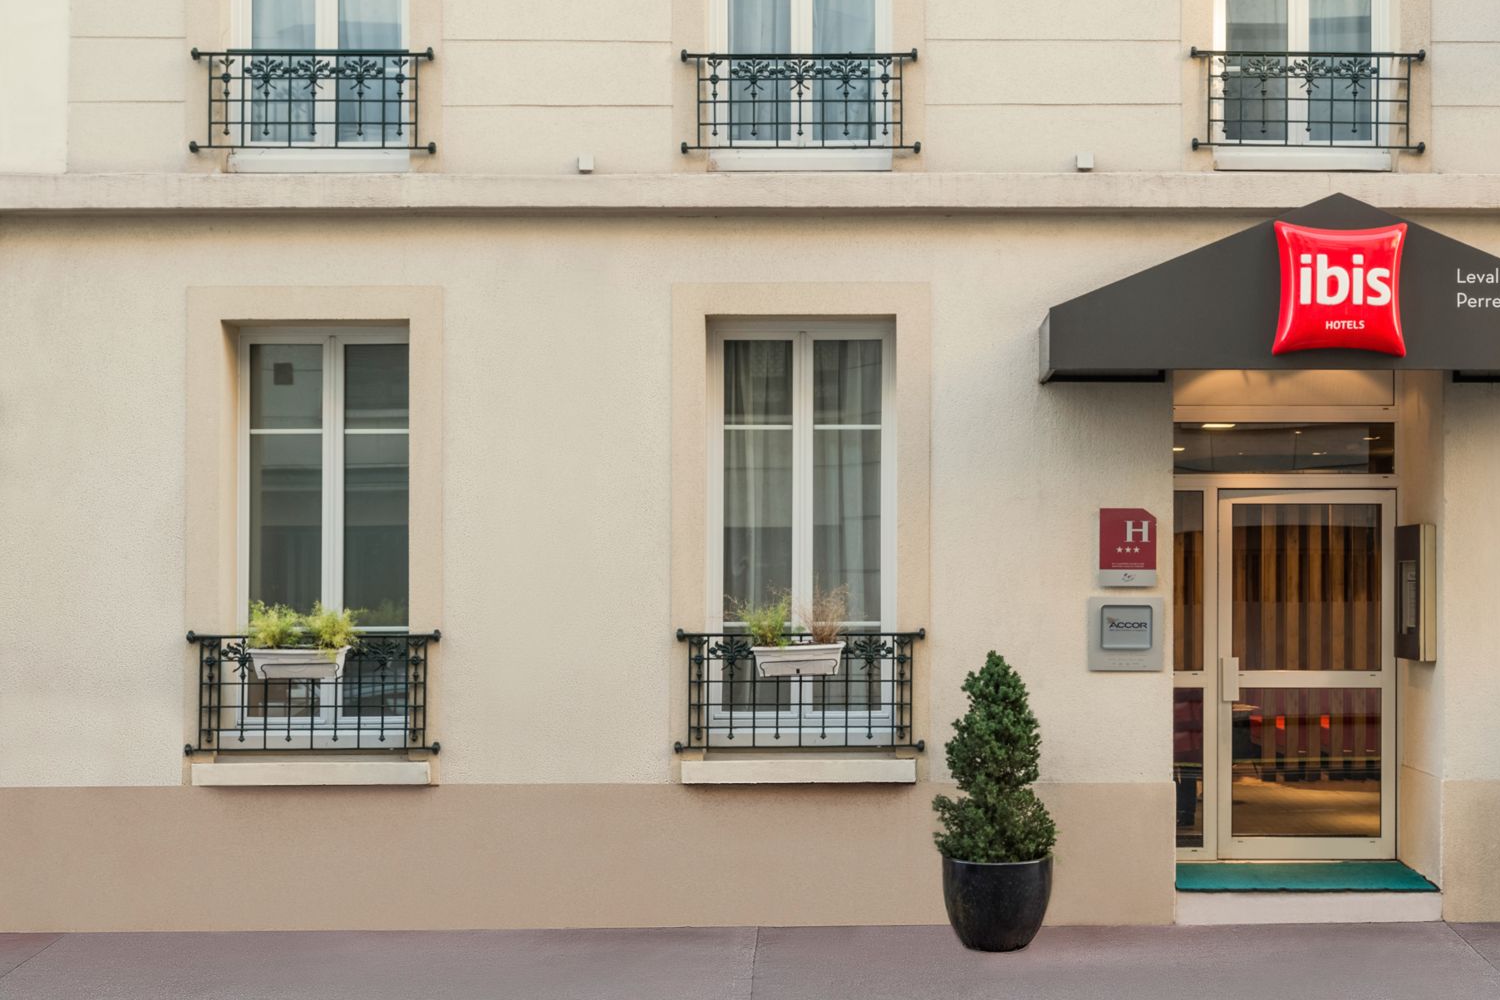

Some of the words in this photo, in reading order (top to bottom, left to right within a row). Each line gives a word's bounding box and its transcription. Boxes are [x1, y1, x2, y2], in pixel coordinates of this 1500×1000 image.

[1299, 253, 1392, 307] ibis
[1325, 319, 1365, 331] HOTELS
[1125, 520, 1151, 543] H
[1109, 621, 1148, 629] ACCOR
